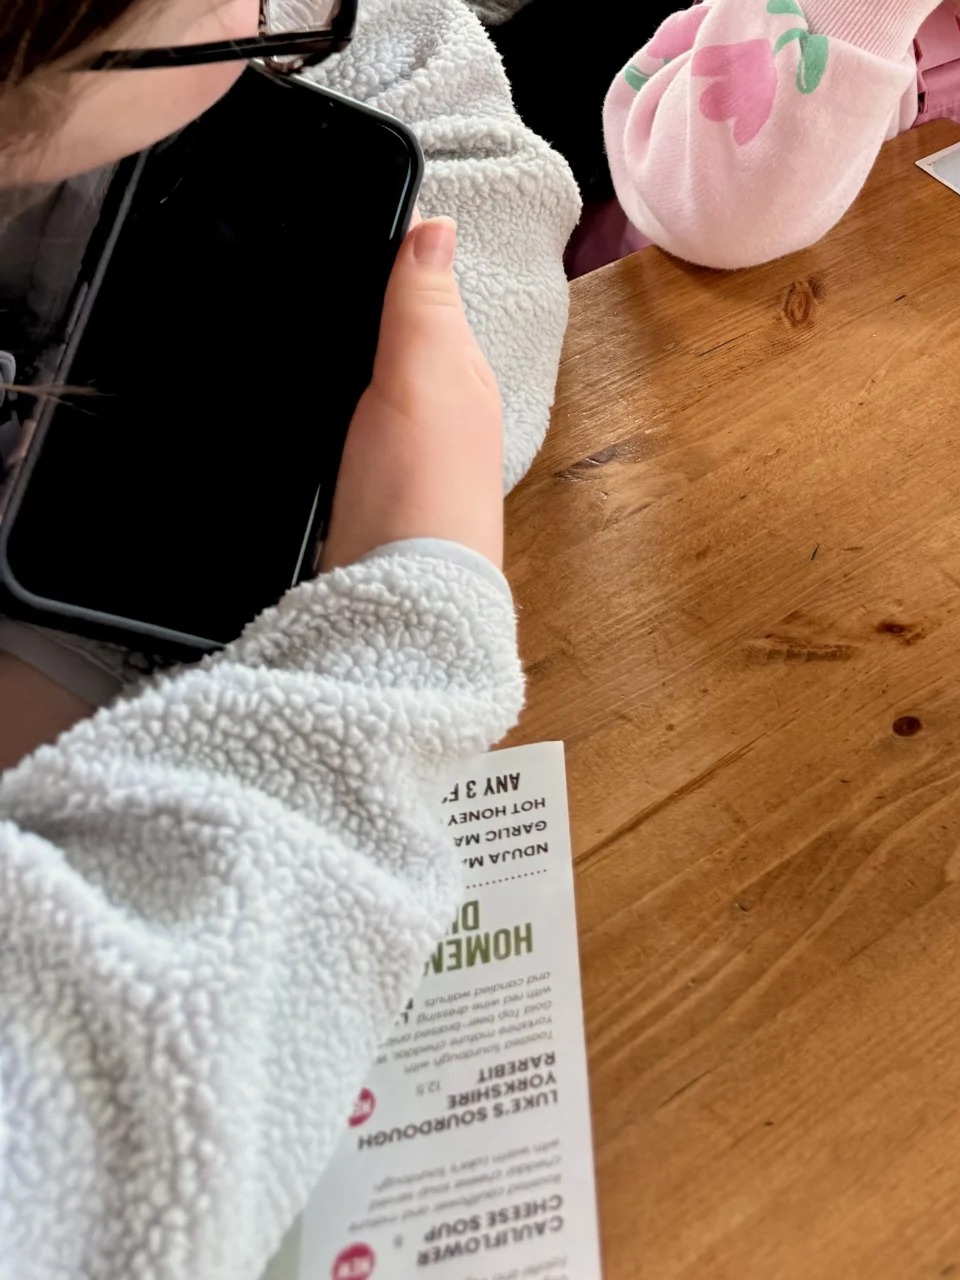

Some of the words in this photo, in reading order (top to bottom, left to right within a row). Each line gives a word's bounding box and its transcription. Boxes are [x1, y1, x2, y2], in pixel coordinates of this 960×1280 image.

[484, 772, 520, 796] ANY
[448, 805, 507, 826] HONEY
[510, 797, 546, 815] HOT
[485, 820, 547, 842] GARLIC
[489, 842, 548, 864] NDUJA
[476, 1050, 556, 1084] RAREBIT
[447, 1070, 556, 1110] YORKSHIRE
[493, 1089, 558, 1117] LUKE'S
[356, 1107, 488, 1150] SOURDOUGH
[486, 1194, 563, 1226] CHEESE
[416, 1215, 564, 1267] CAULIFLOWER
[423, 1215, 482, 1242] SOUP
